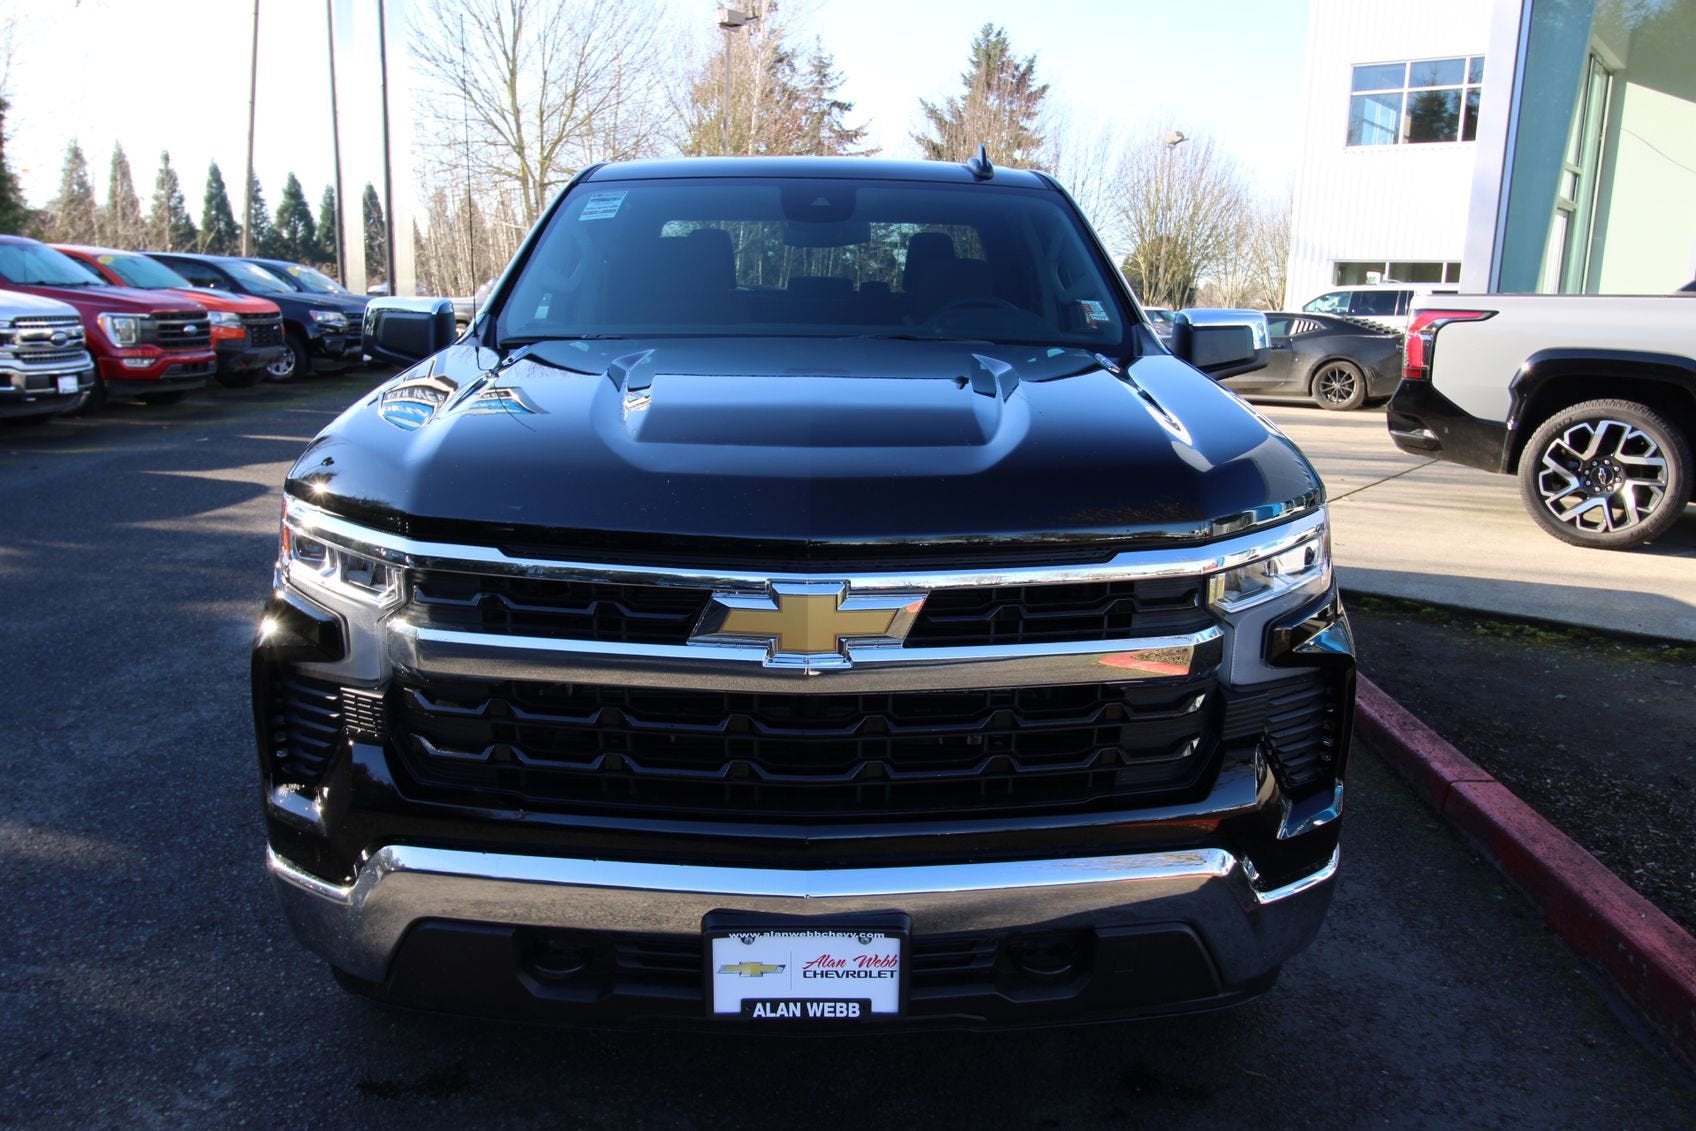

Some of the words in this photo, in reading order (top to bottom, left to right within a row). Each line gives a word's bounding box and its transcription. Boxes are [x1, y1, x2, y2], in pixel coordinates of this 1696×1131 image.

[728, 930, 885, 939] www.alanwebbchevy.com
[802, 953, 847, 970] Alan
[853, 953, 898, 969] Webb
[802, 969, 897, 979] CHEVROLET
[753, 1002, 801, 1018] ALAN
[806, 1002, 861, 1018] WEBB
